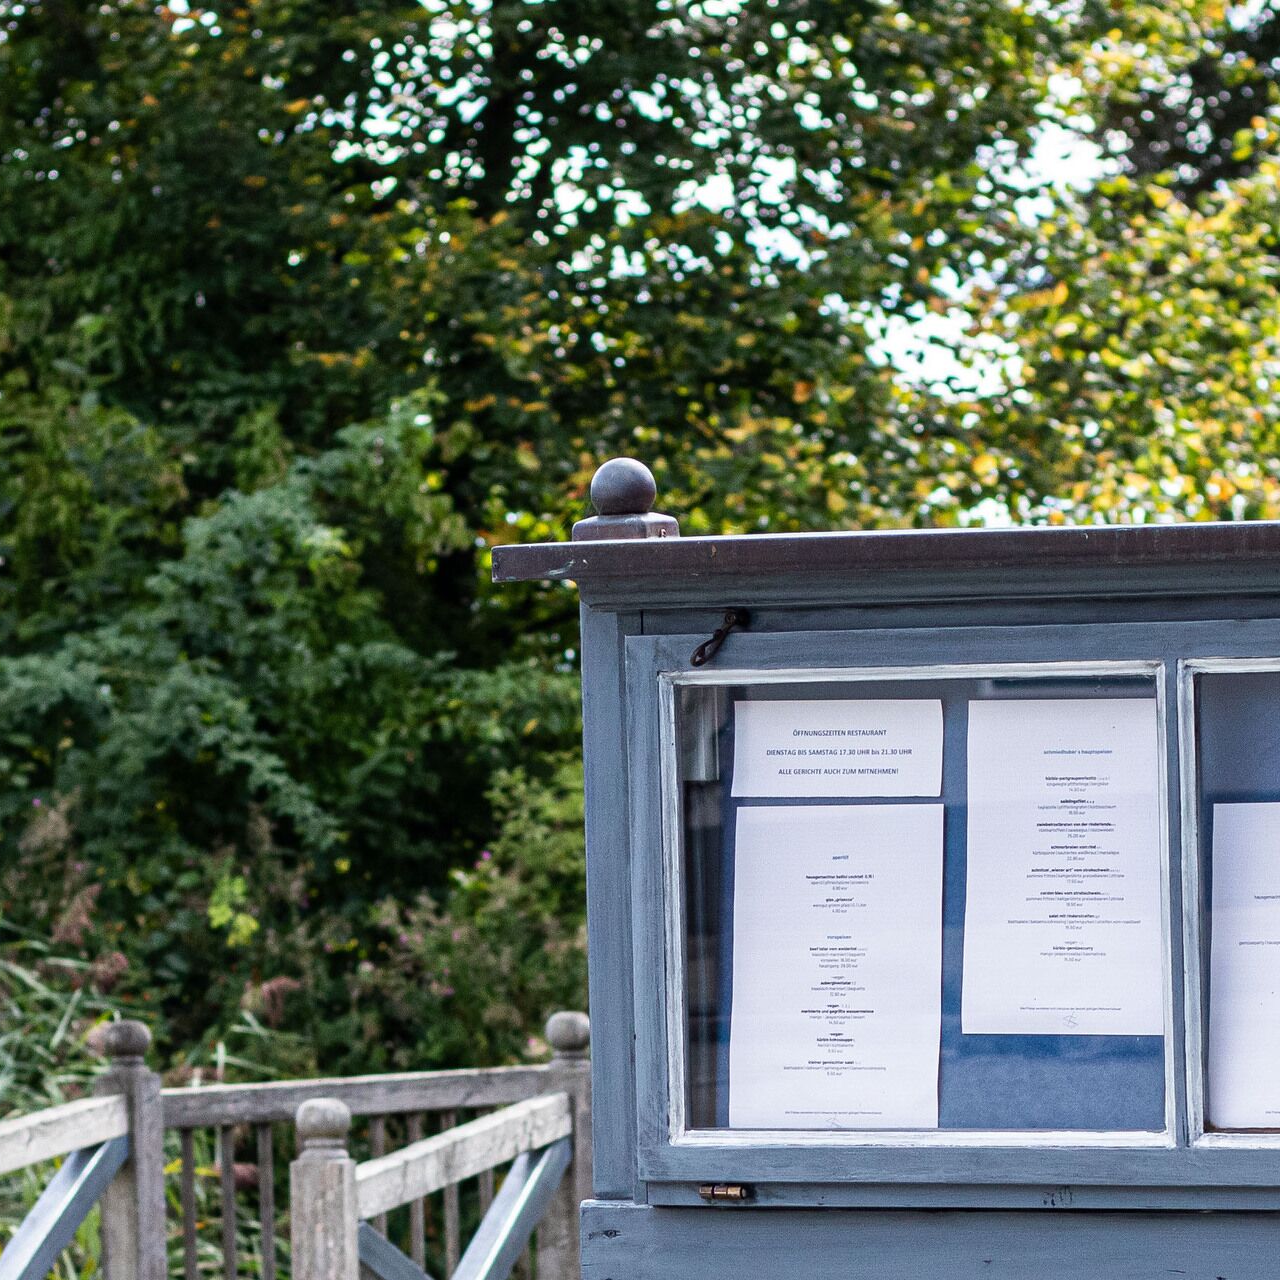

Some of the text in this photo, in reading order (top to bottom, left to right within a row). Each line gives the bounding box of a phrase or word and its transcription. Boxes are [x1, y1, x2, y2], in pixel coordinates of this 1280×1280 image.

[792, 728, 887, 737] ÖFFNUNGSZEITEN RESTAURANT
[898, 748, 912, 756] UHR
[778, 768, 792, 776] ALLE
